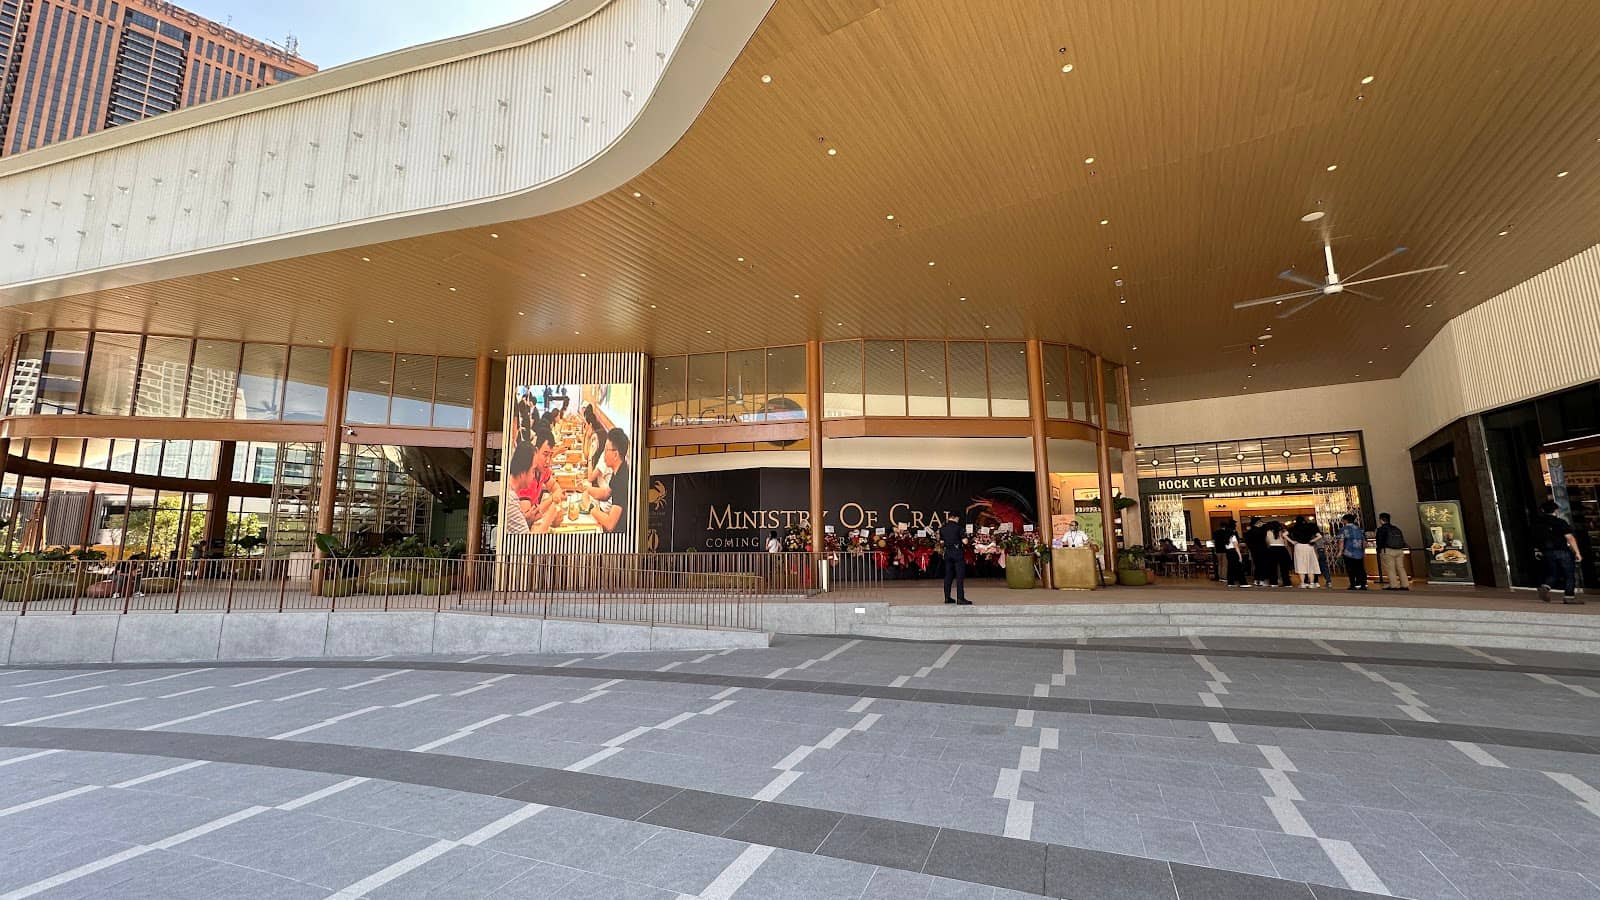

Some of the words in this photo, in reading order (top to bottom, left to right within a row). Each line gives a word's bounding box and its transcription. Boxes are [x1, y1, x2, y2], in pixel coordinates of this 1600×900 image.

[131, 0, 200, 26] MES
[1158, 479, 1189, 490] HOCK
[1193, 478, 1216, 488] KEE
[1220, 474, 1282, 487] KOPITIAM
[706, 503, 829, 530] MINISTR
[839, 502, 879, 529] OF
[706, 537, 759, 548] COMING
